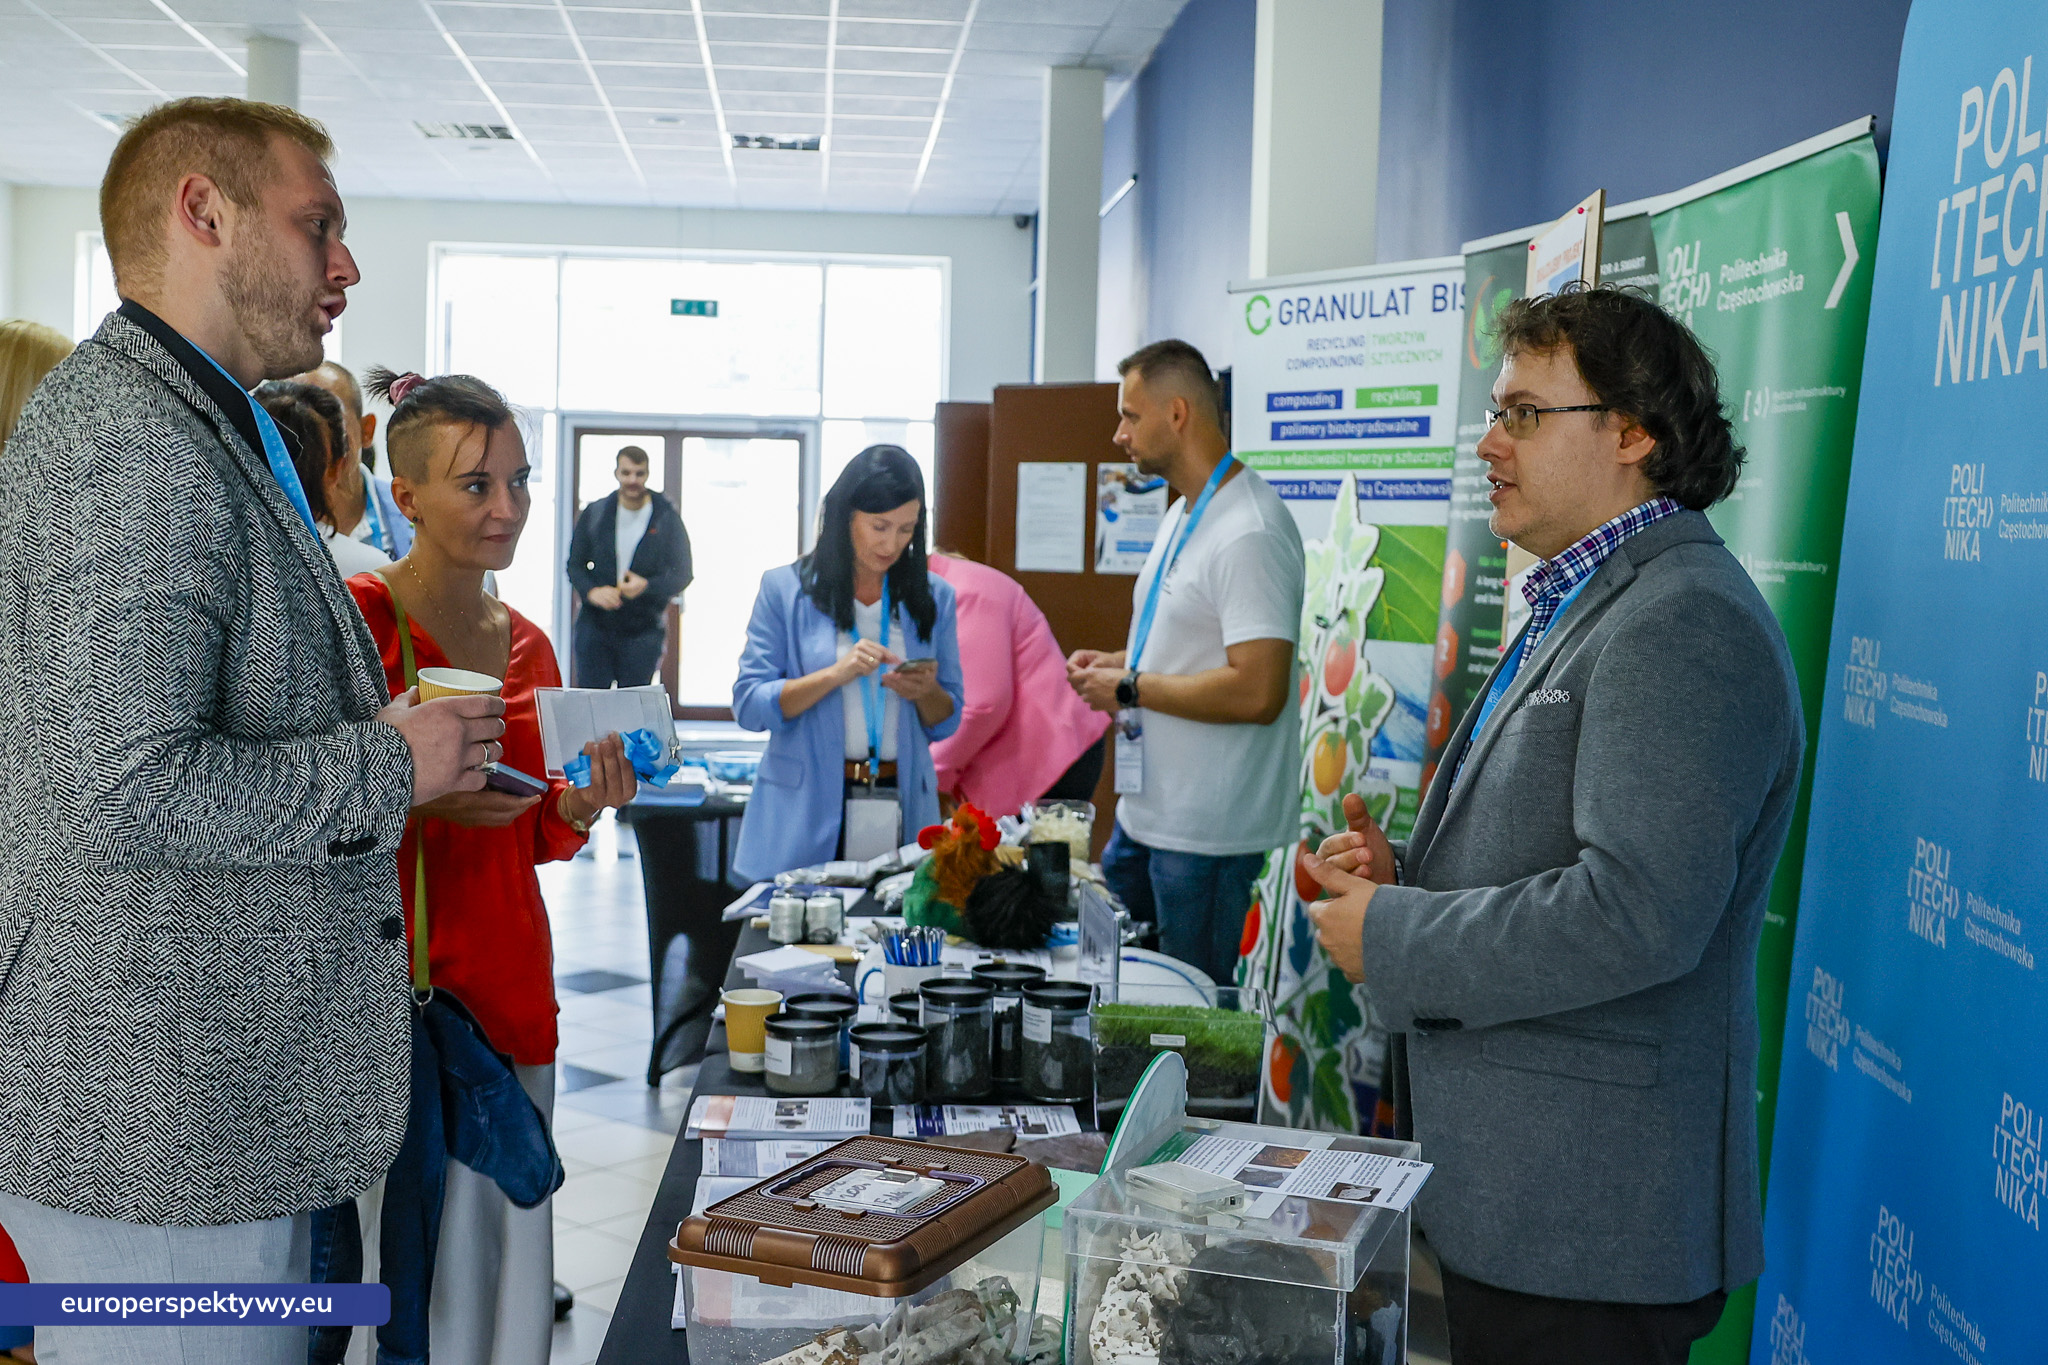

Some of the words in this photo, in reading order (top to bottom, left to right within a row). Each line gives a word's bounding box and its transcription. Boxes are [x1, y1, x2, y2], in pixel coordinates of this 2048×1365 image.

[1953, 55, 2048, 184] POL
[1719, 247, 1788, 285] Politechnika
[1278, 286, 1415, 325] GRANULAT
[1717, 270, 1805, 312] Częstochowska
[1307, 334, 1365, 350] RECYCLING
[1934, 267, 2048, 387] NIKA
[1950, 462, 1985, 495] POLI
[1944, 530, 1981, 562] NIKA
[1851, 636, 1881, 668] POLI
[1844, 694, 1877, 730] NIKA
[1914, 836, 1951, 879] POLI
[1908, 902, 1946, 949] NIKA
[1966, 891, 2021, 936] Politechnika
[1964, 916, 2034, 971] Częstochowska
[1812, 965, 1844, 1011] POLI
[1806, 1023, 1839, 1073] NIKA
[2001, 1091, 2043, 1152] POLI
[1995, 1165, 2039, 1232] NIKA
[1878, 1204, 1914, 1261] POLI
[1871, 1268, 1909, 1331] NIKA
[1930, 1283, 1986, 1353] Politechnika
